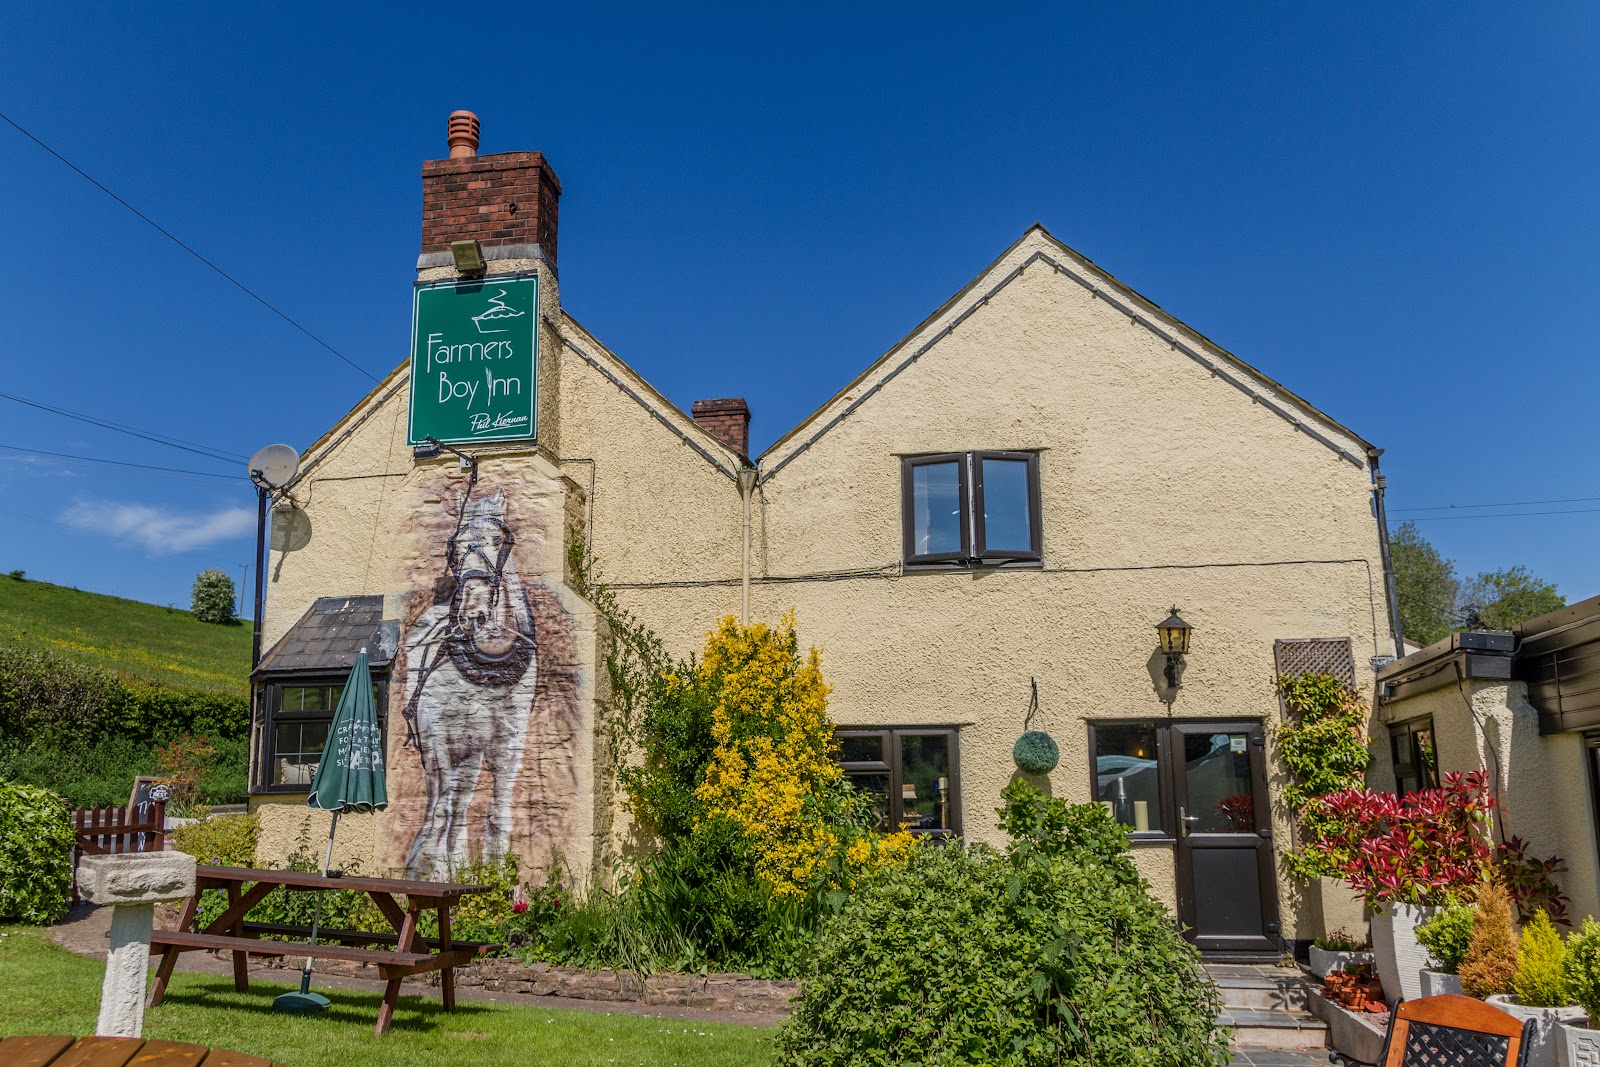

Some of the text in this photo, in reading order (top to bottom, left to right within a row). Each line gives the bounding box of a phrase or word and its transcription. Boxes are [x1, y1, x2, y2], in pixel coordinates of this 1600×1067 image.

[427, 333, 513, 373] Farmers
[438, 367, 521, 410] Boy Inn
[469, 412, 491, 431] Phil
